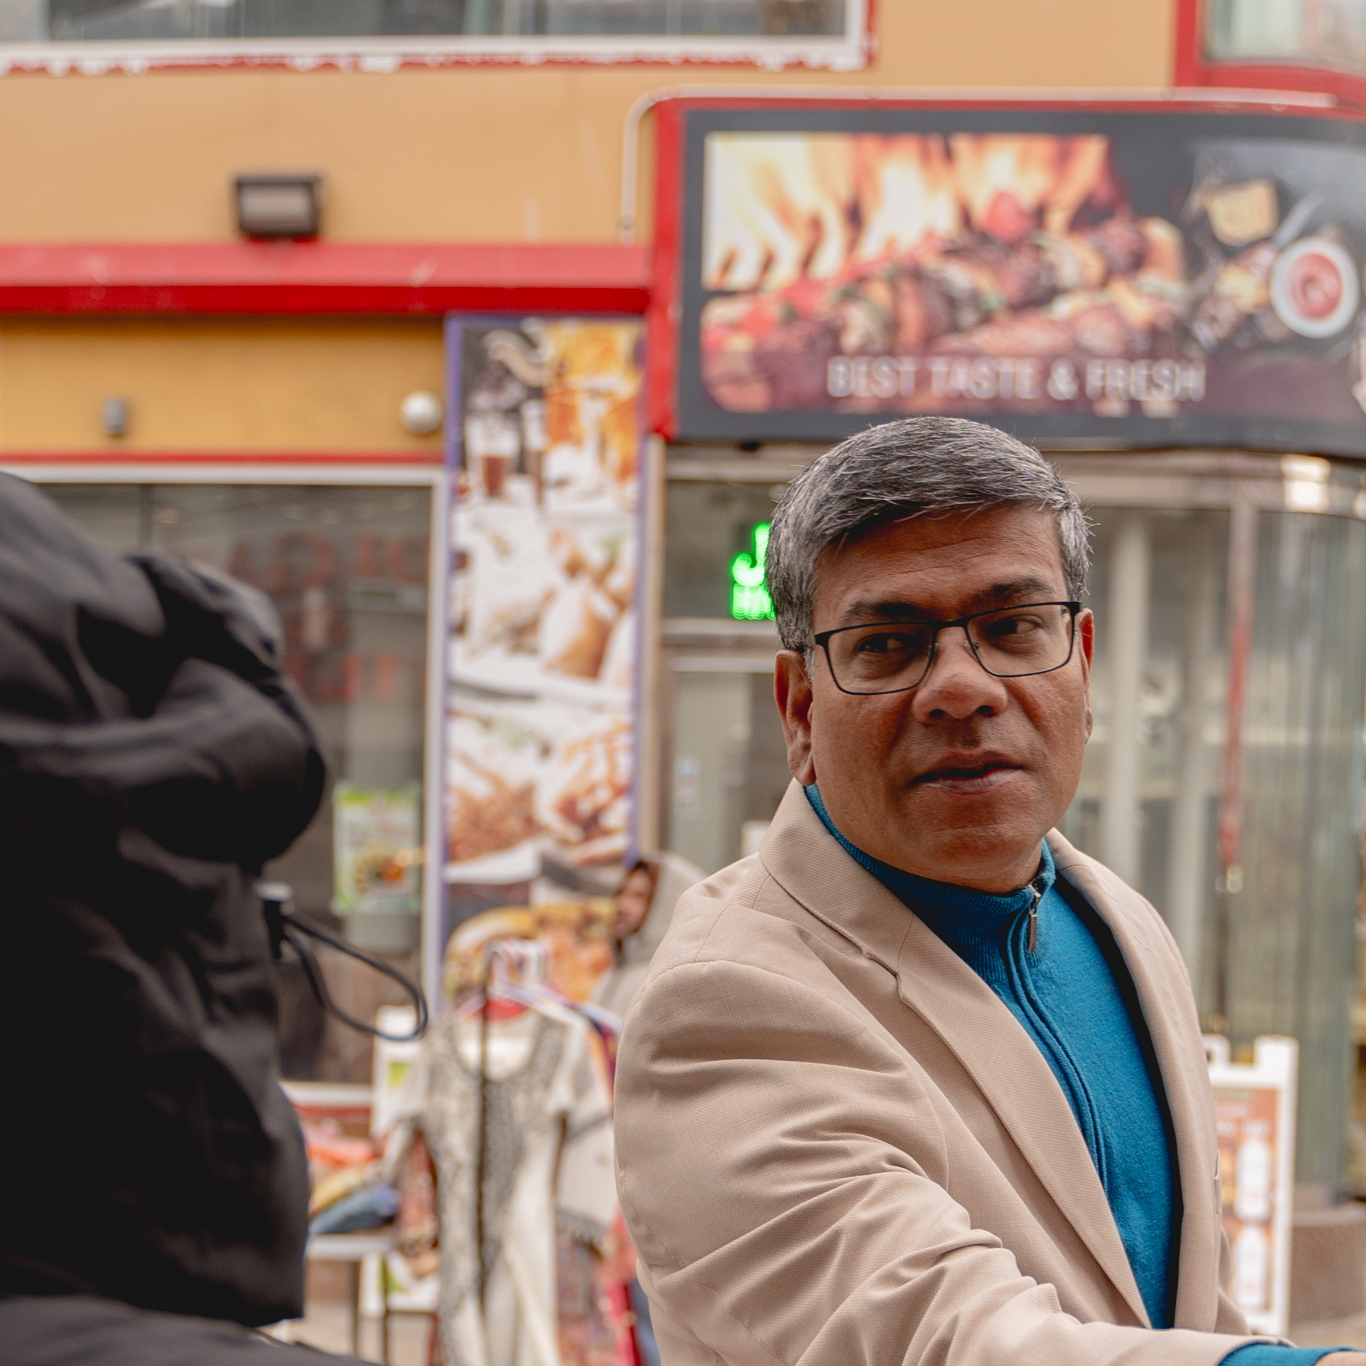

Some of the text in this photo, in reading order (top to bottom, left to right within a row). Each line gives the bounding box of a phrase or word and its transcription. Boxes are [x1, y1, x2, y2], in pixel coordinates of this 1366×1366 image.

[827, 355, 1206, 401] BEST TASTE & FRESH
